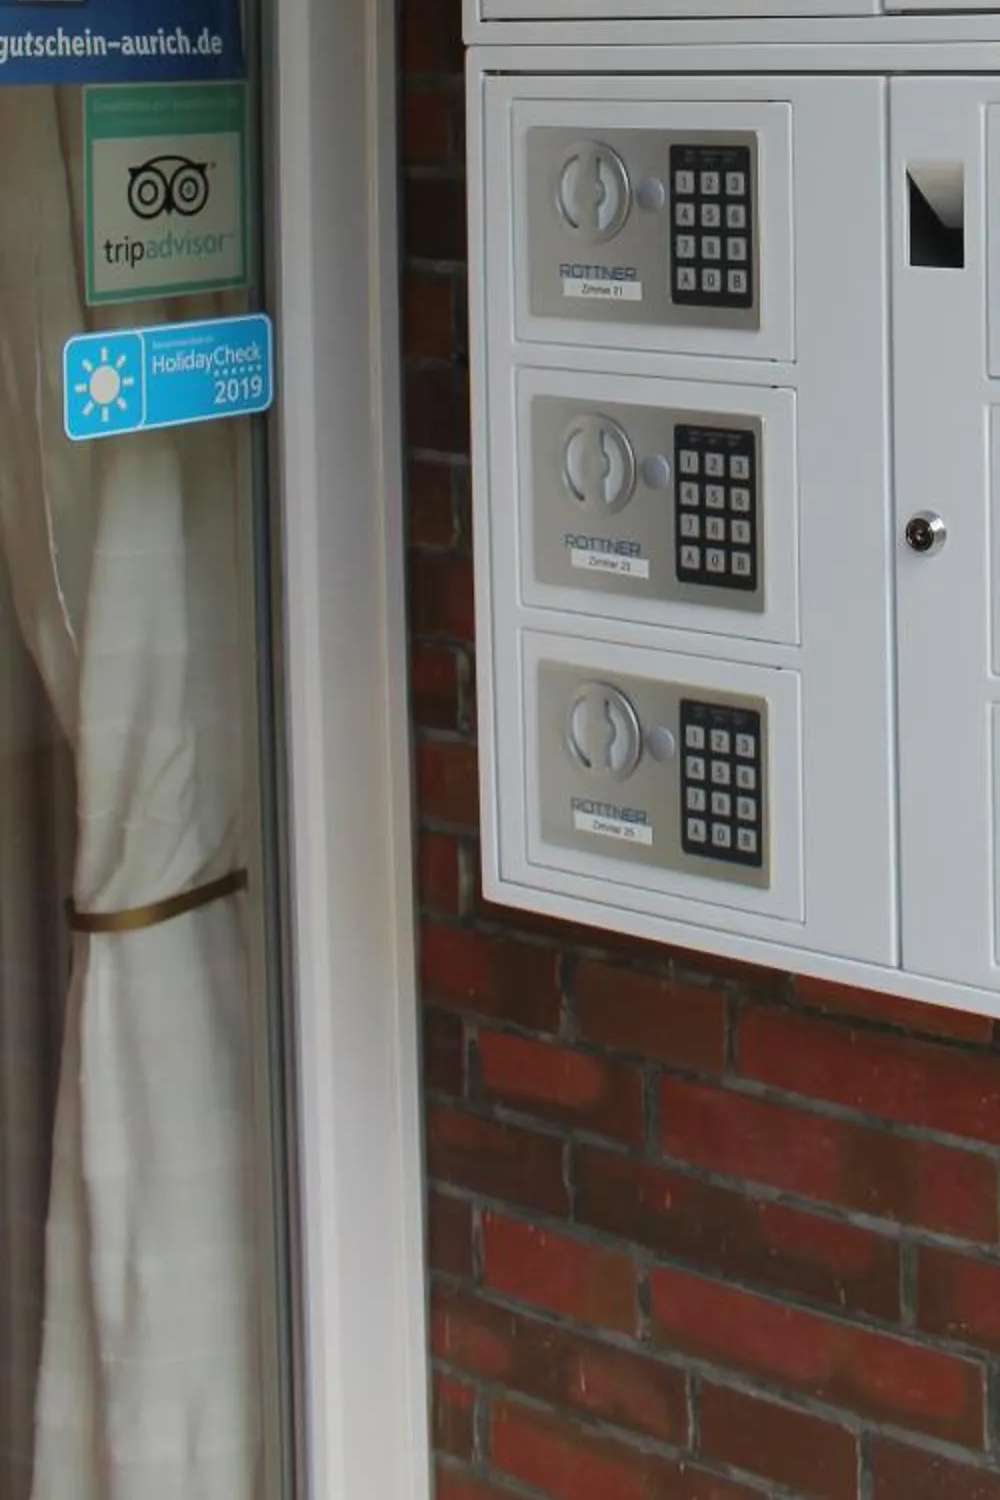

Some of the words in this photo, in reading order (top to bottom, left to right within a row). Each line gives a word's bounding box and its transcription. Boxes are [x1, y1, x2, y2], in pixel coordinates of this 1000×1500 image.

[102, 230, 226, 269] tripadvisor
[151, 340, 262, 376] HolidayCheck
[213, 373, 263, 405] 2019
